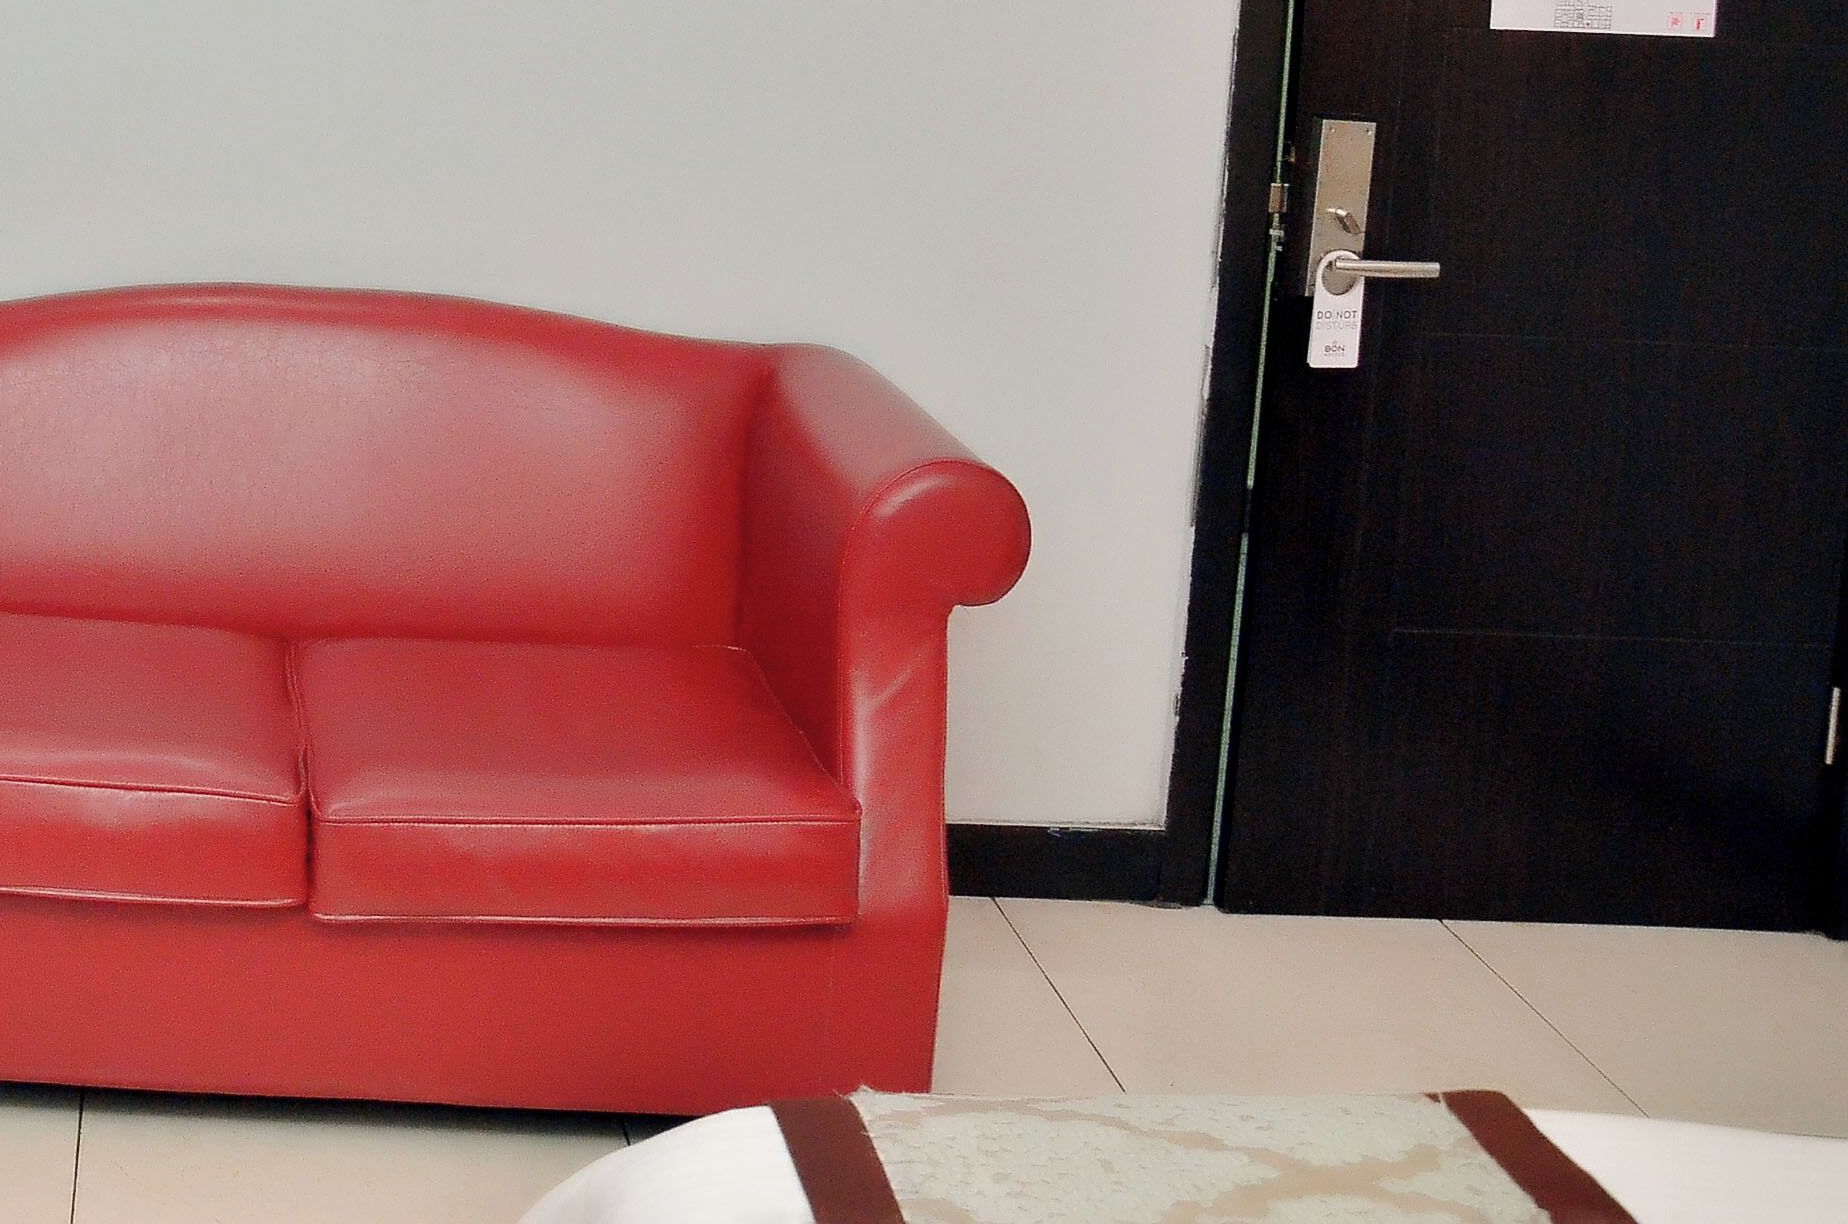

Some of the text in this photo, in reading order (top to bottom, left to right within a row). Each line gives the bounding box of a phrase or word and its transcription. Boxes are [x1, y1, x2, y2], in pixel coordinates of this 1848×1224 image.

[1317, 310, 1357, 320] DO NOT
[1316, 321, 1357, 329] DISTURB
[1324, 345, 1345, 353] BON
